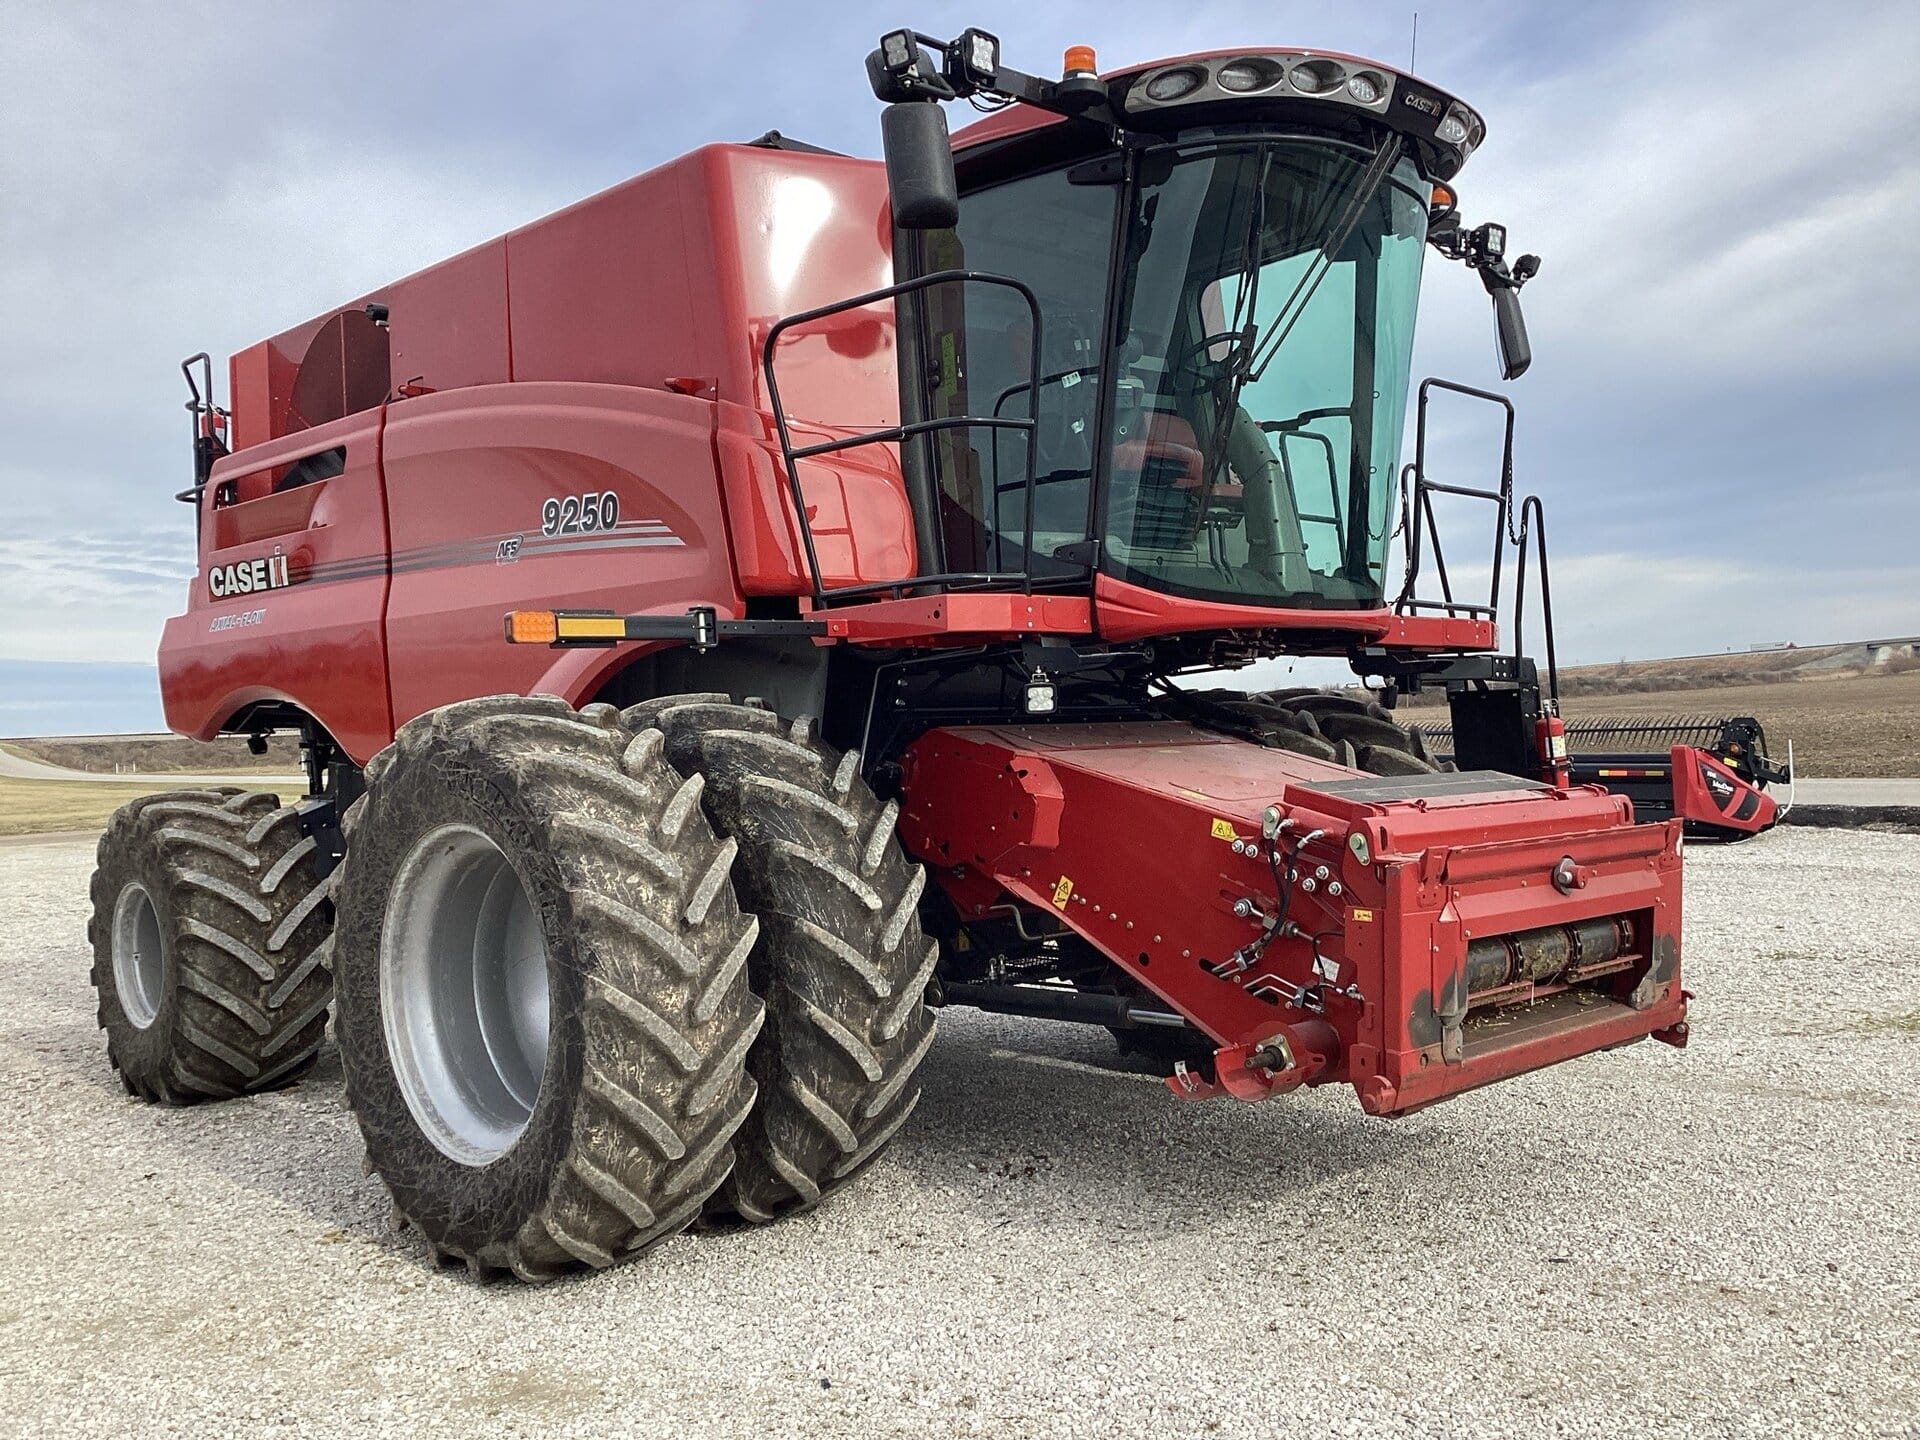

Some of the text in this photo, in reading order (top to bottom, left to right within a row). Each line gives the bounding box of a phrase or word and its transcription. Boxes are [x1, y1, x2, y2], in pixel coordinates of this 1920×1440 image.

[1405, 95, 1431, 113] CASE
[542, 491, 619, 537] 9250
[496, 537, 521, 559] AFS
[209, 559, 267, 597] CASE
